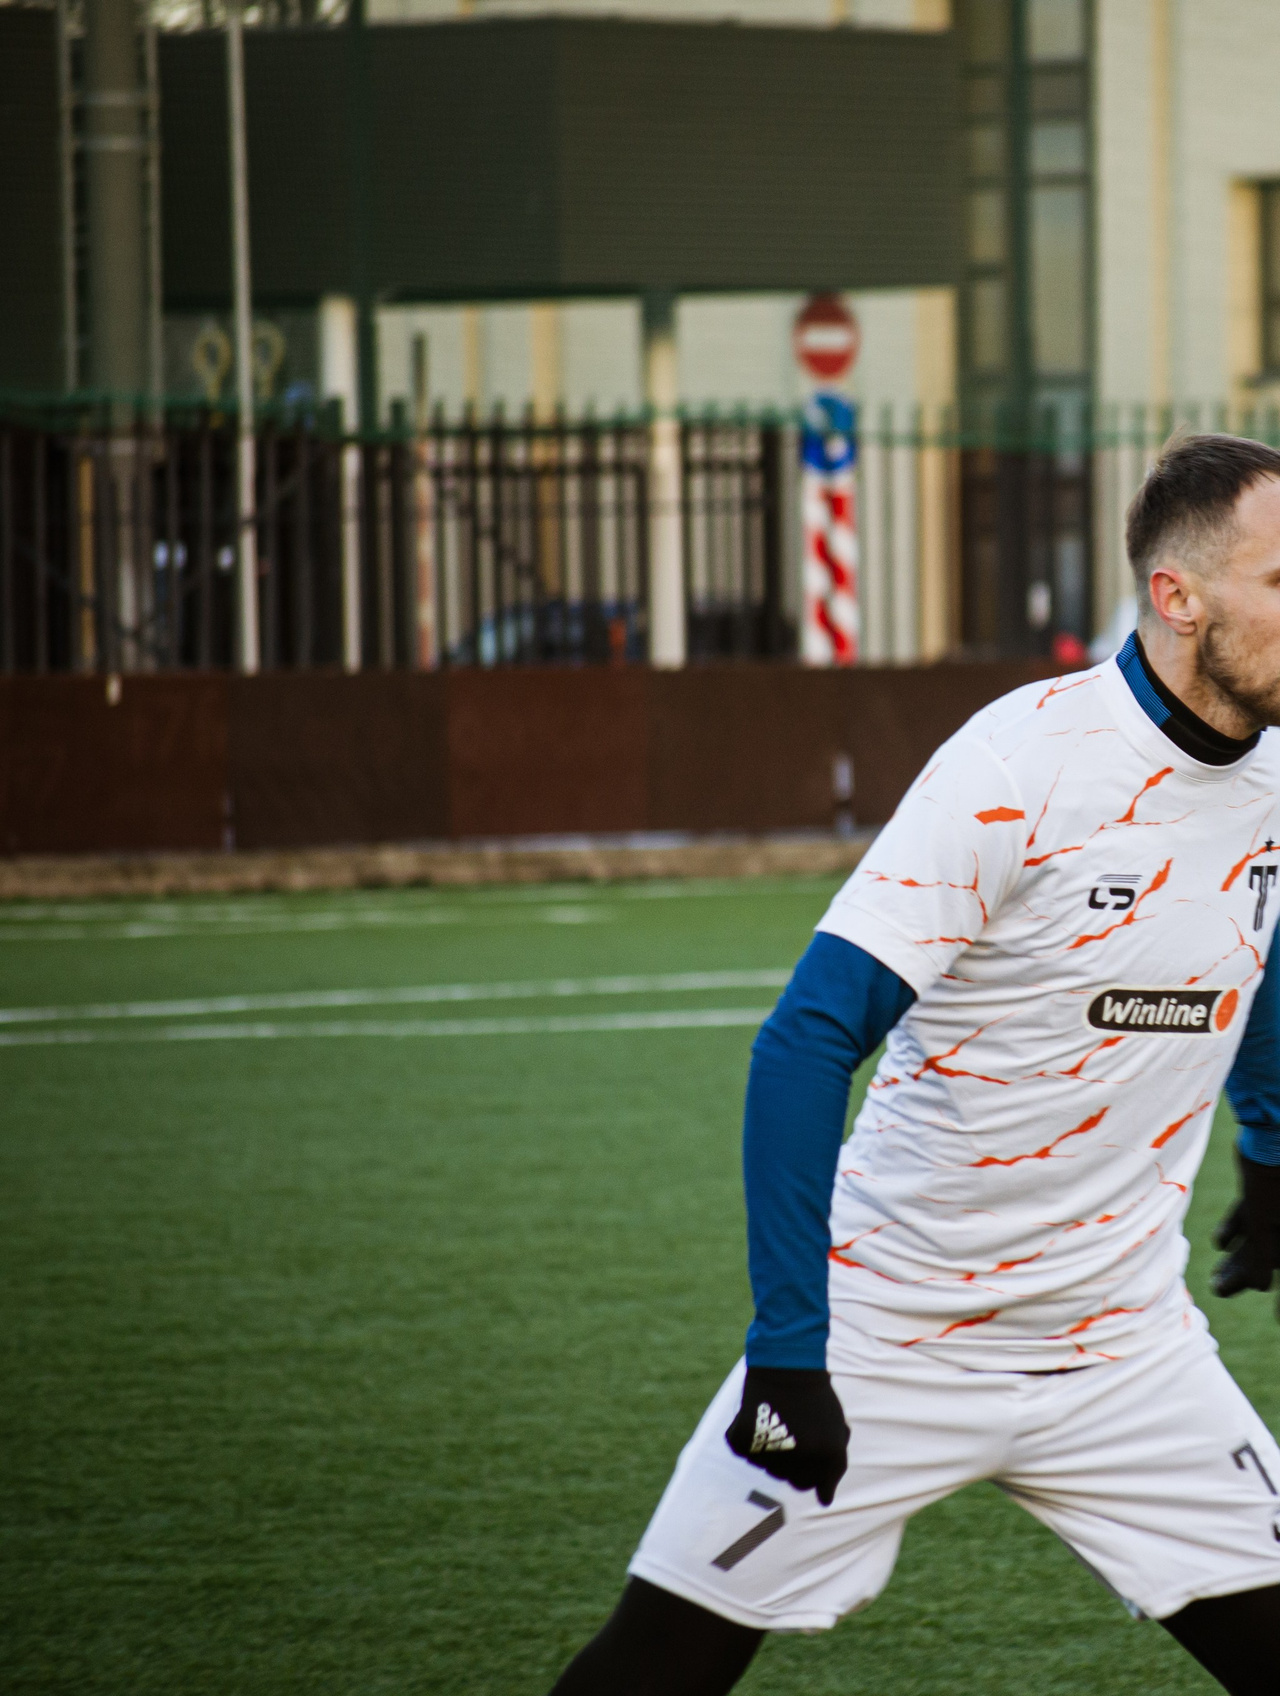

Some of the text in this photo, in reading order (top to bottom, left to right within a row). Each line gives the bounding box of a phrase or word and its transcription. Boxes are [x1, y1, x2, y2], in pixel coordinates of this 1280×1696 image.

[1102, 996, 1208, 1026] Winline
[1230, 1441, 1278, 1495] 7
[711, 1489, 786, 1572] 7
